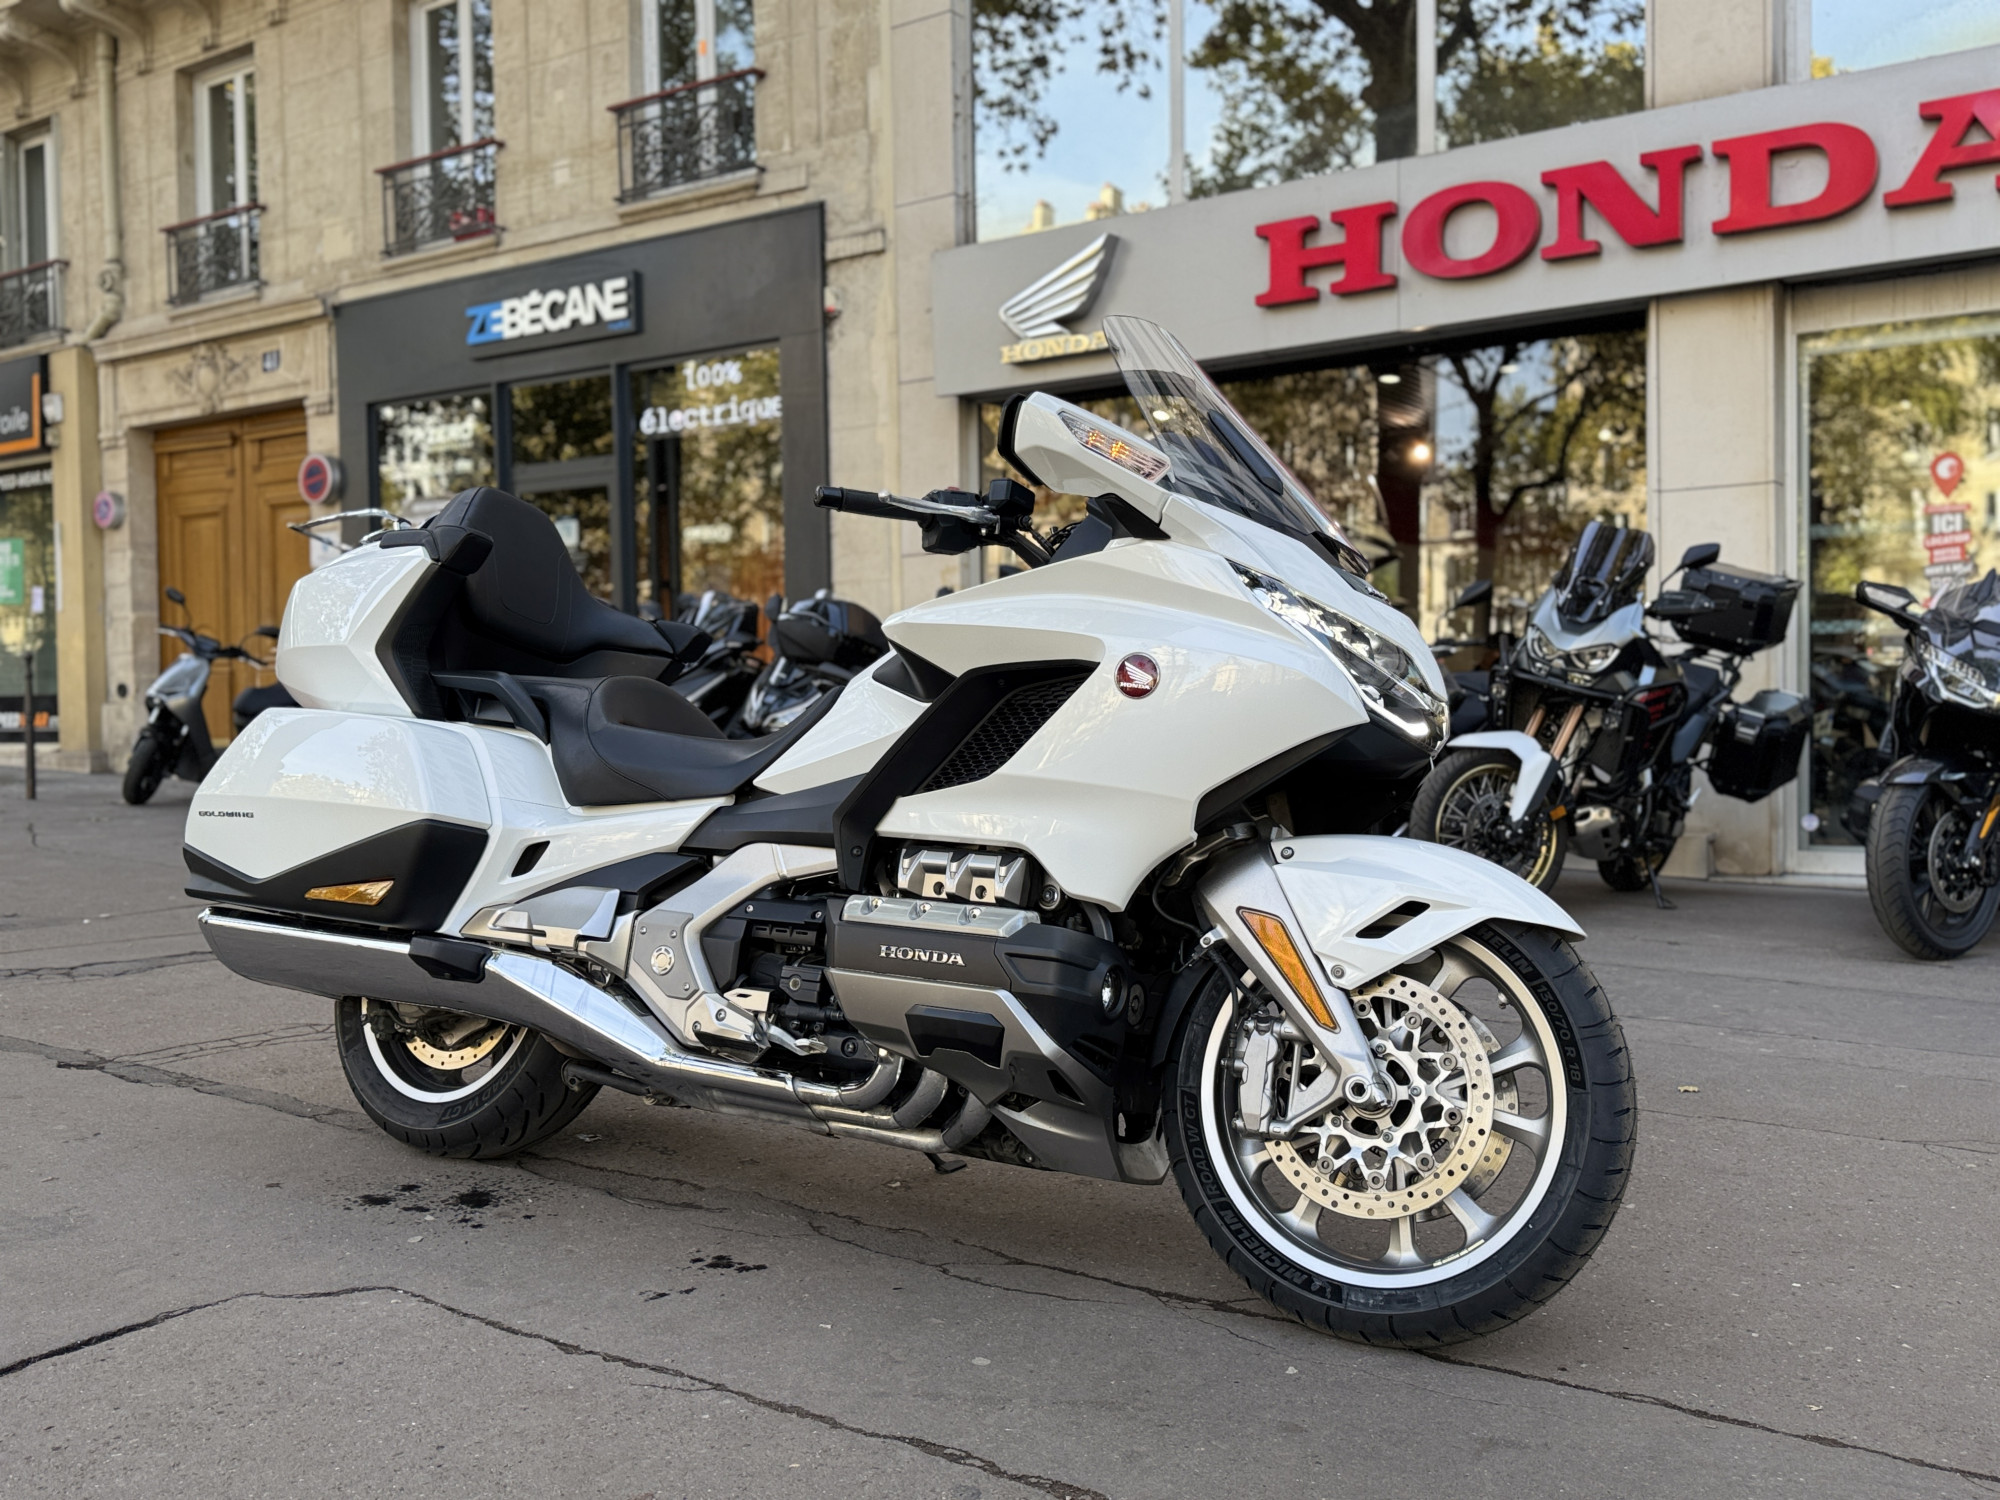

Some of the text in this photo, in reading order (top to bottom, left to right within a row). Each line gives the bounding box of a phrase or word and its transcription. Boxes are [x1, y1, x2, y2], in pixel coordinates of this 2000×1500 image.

[1255, 88, 2000, 308] HONDA
[1000, 330, 1109, 364] HONDA
[683, 359, 743, 391] 100%
[639, 394, 783, 435] électrique
[1932, 513, 1963, 534] ICI
[1120, 681, 1151, 690] HONDA
[879, 944, 966, 967] HONDA
